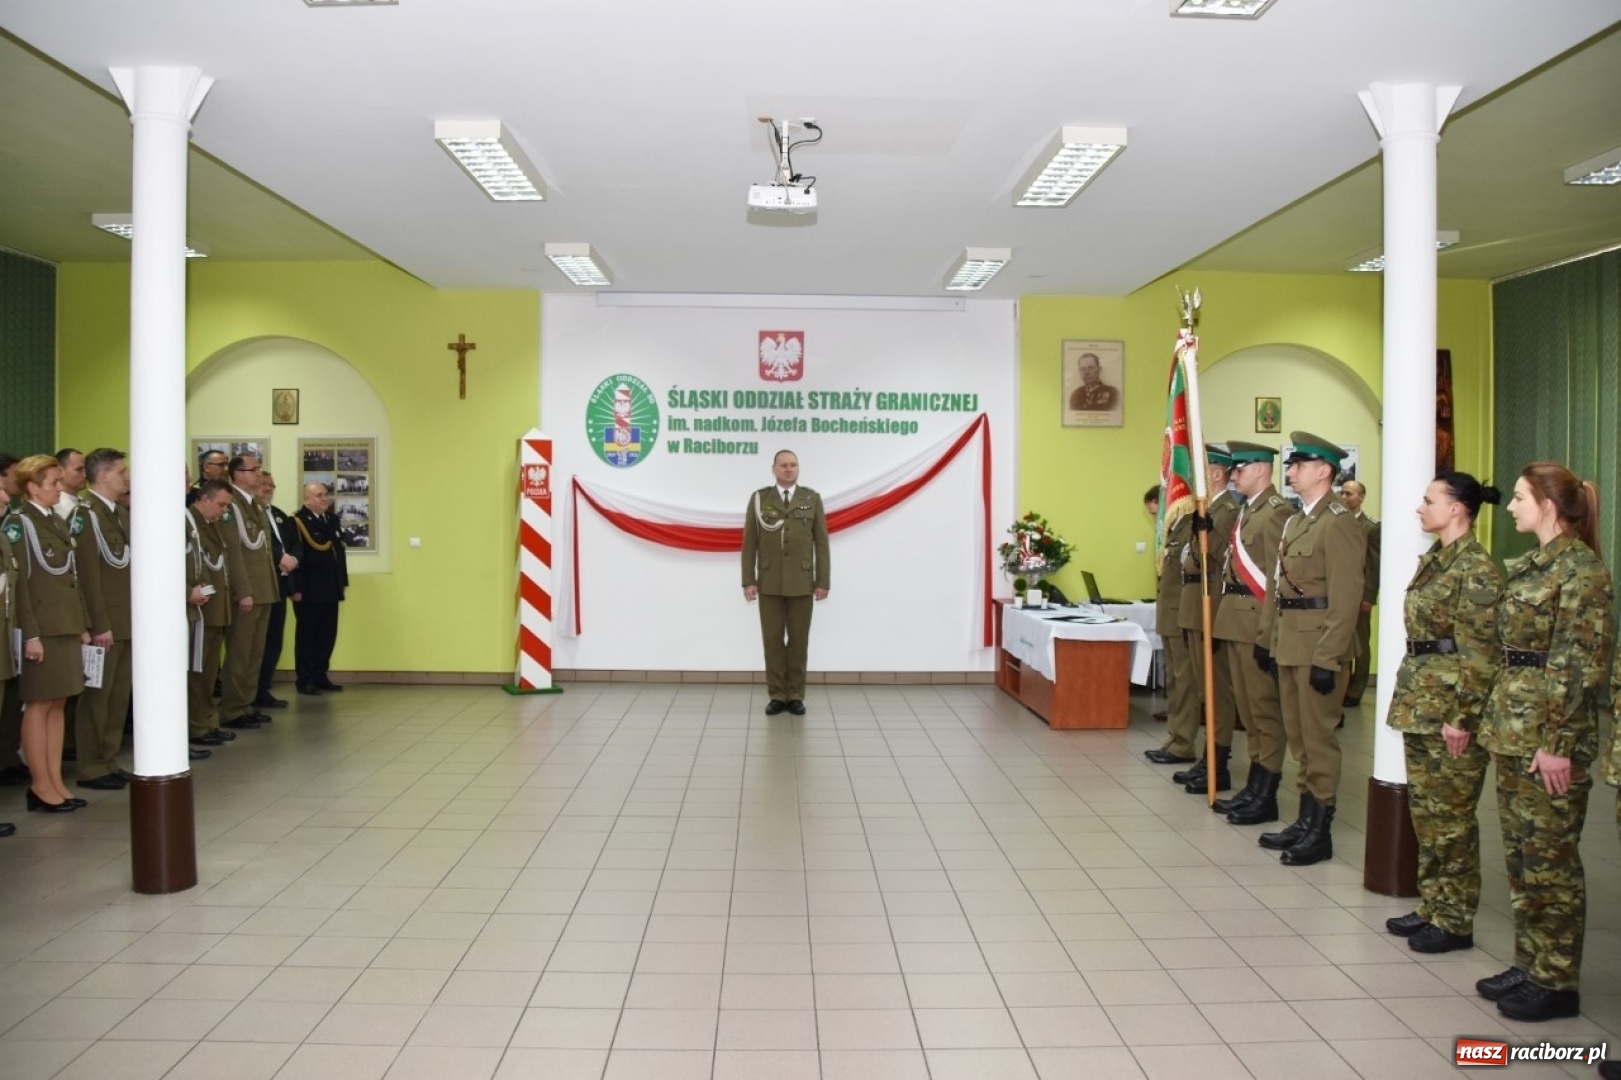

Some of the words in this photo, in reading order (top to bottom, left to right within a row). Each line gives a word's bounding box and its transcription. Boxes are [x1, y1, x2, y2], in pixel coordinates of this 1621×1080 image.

[668, 385, 728, 411] ŚLĄSKI
[733, 390, 804, 410] ODDZIAŁ
[808, 387, 872, 410] STRAŻY
[876, 392, 978, 412] GRANICZNEJ
[668, 415, 690, 431] im.
[694, 416, 758, 432] nadkom.
[761, 416, 807, 433] Józefa
[811, 416, 919, 436] Bocheńskiego
[667, 440, 680, 453] w
[684, 438, 759, 454] Raciborzu
